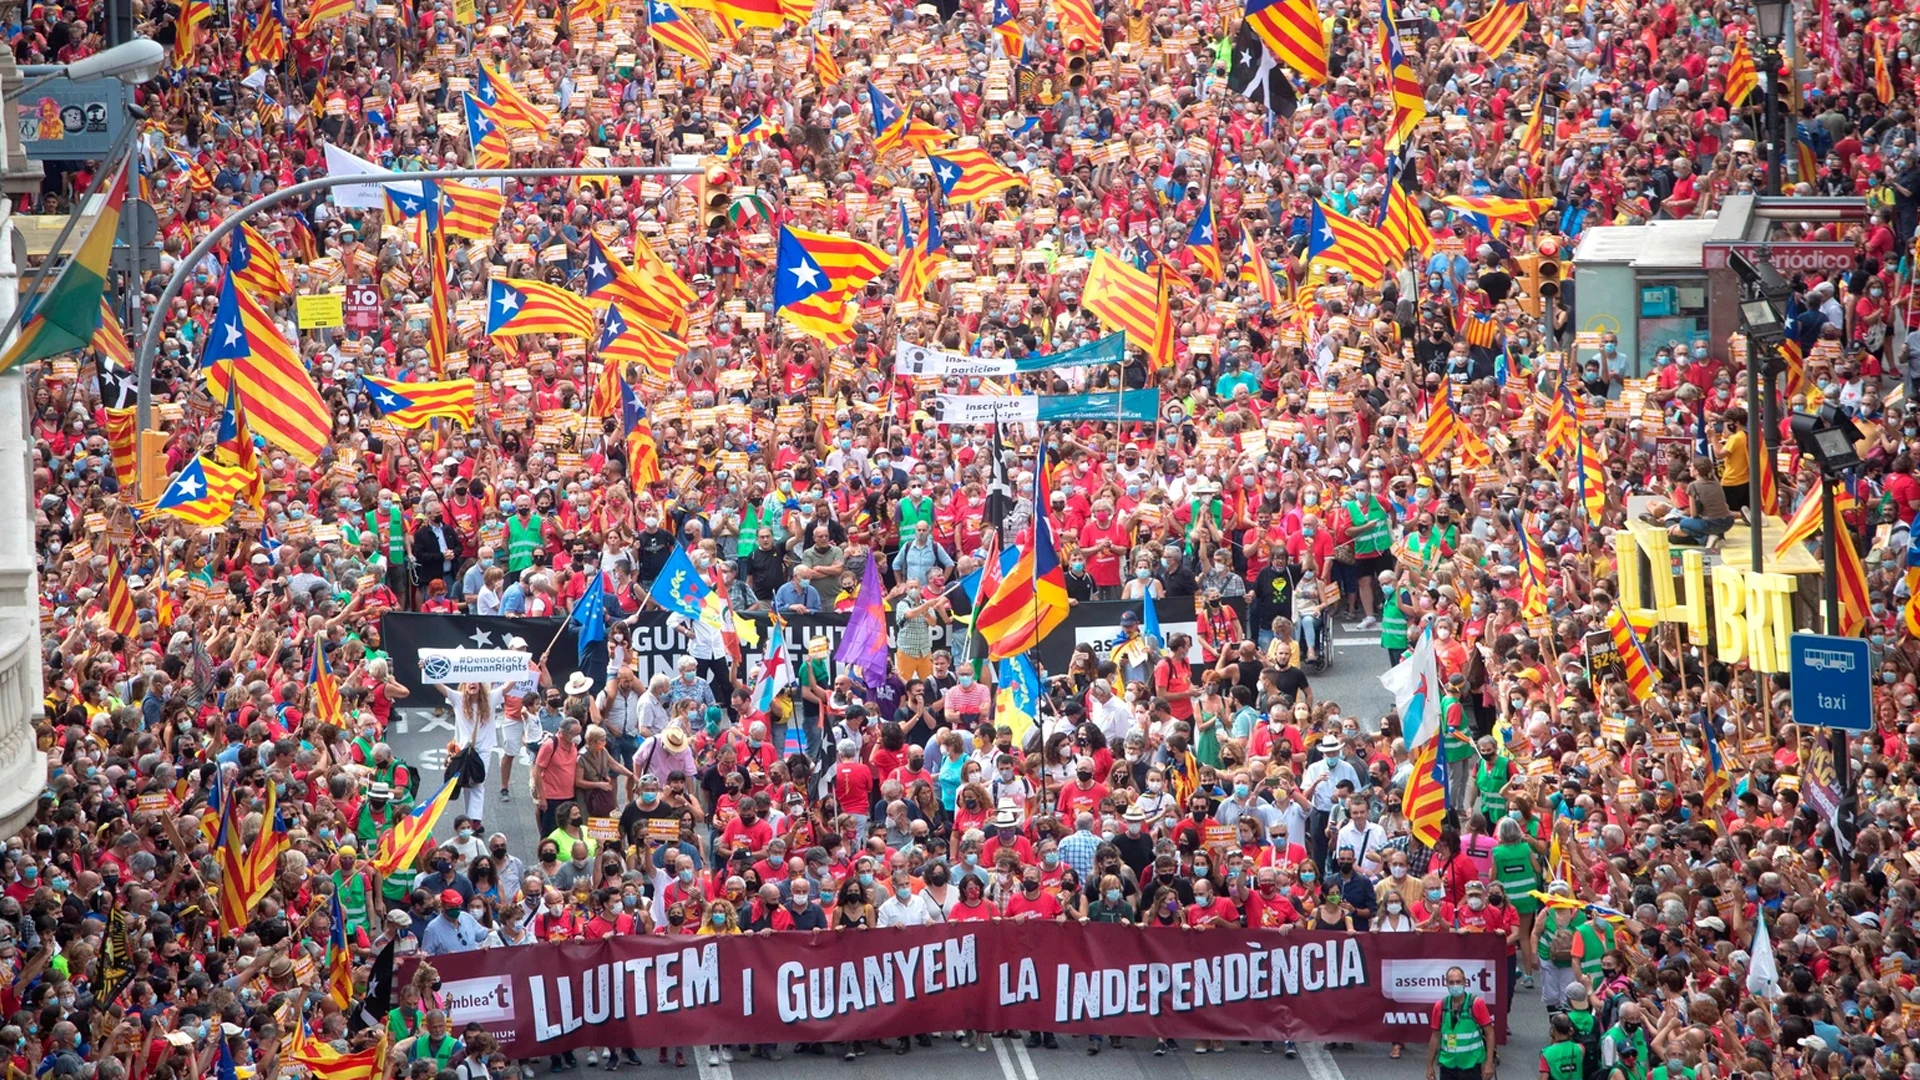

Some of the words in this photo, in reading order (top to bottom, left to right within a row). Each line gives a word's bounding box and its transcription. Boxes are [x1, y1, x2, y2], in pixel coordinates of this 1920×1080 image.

[459, 655, 524, 664] #Democracy
[453, 663, 527, 673] #HumanRights
[1817, 692, 1846, 711] taxi
[528, 942, 720, 1043] LLUITEM
[777, 933, 978, 1024] GUANYEM
[999, 957, 1040, 1006] LA
[1055, 937, 1366, 1023] INDEPENDÈNCIA
